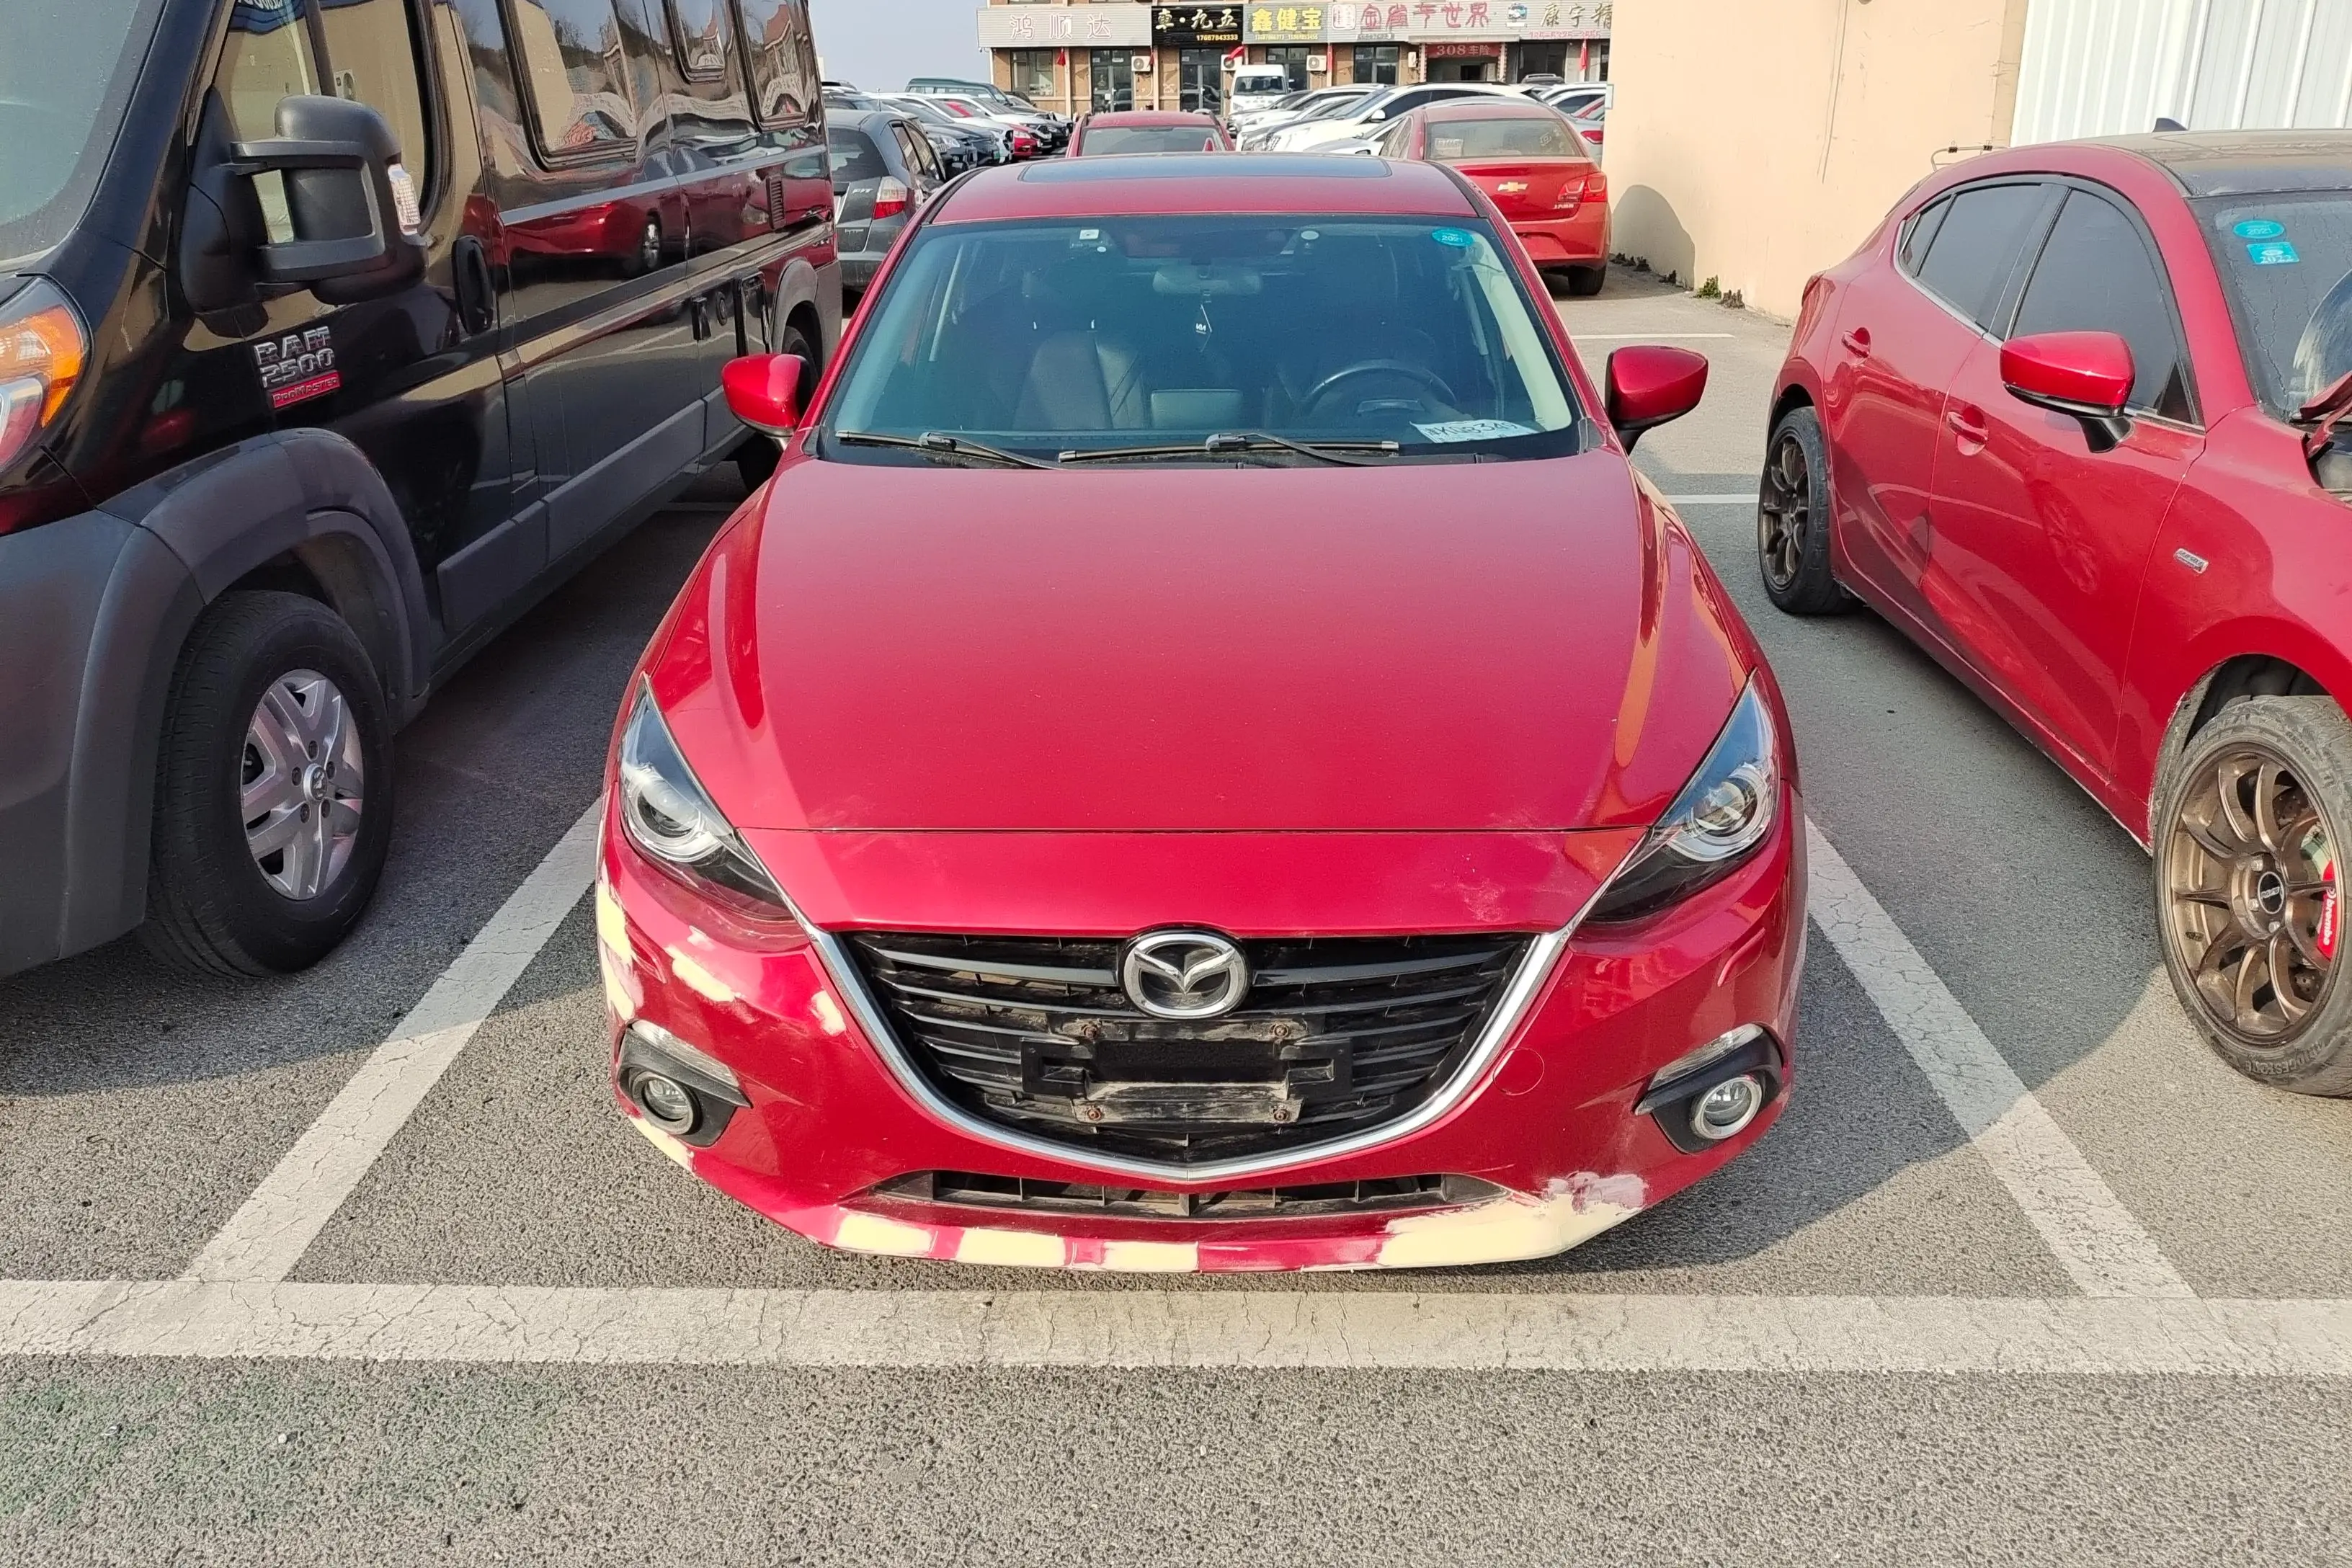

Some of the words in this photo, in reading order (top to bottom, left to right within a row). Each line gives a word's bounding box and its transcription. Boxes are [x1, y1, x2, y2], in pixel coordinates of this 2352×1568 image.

[1010, 13, 1112, 40] 鸿顺达
[1252, 7, 1322, 32] 鑫健宝
[1437, 45, 1466, 55] 308
[259, 348, 335, 388] 2500
